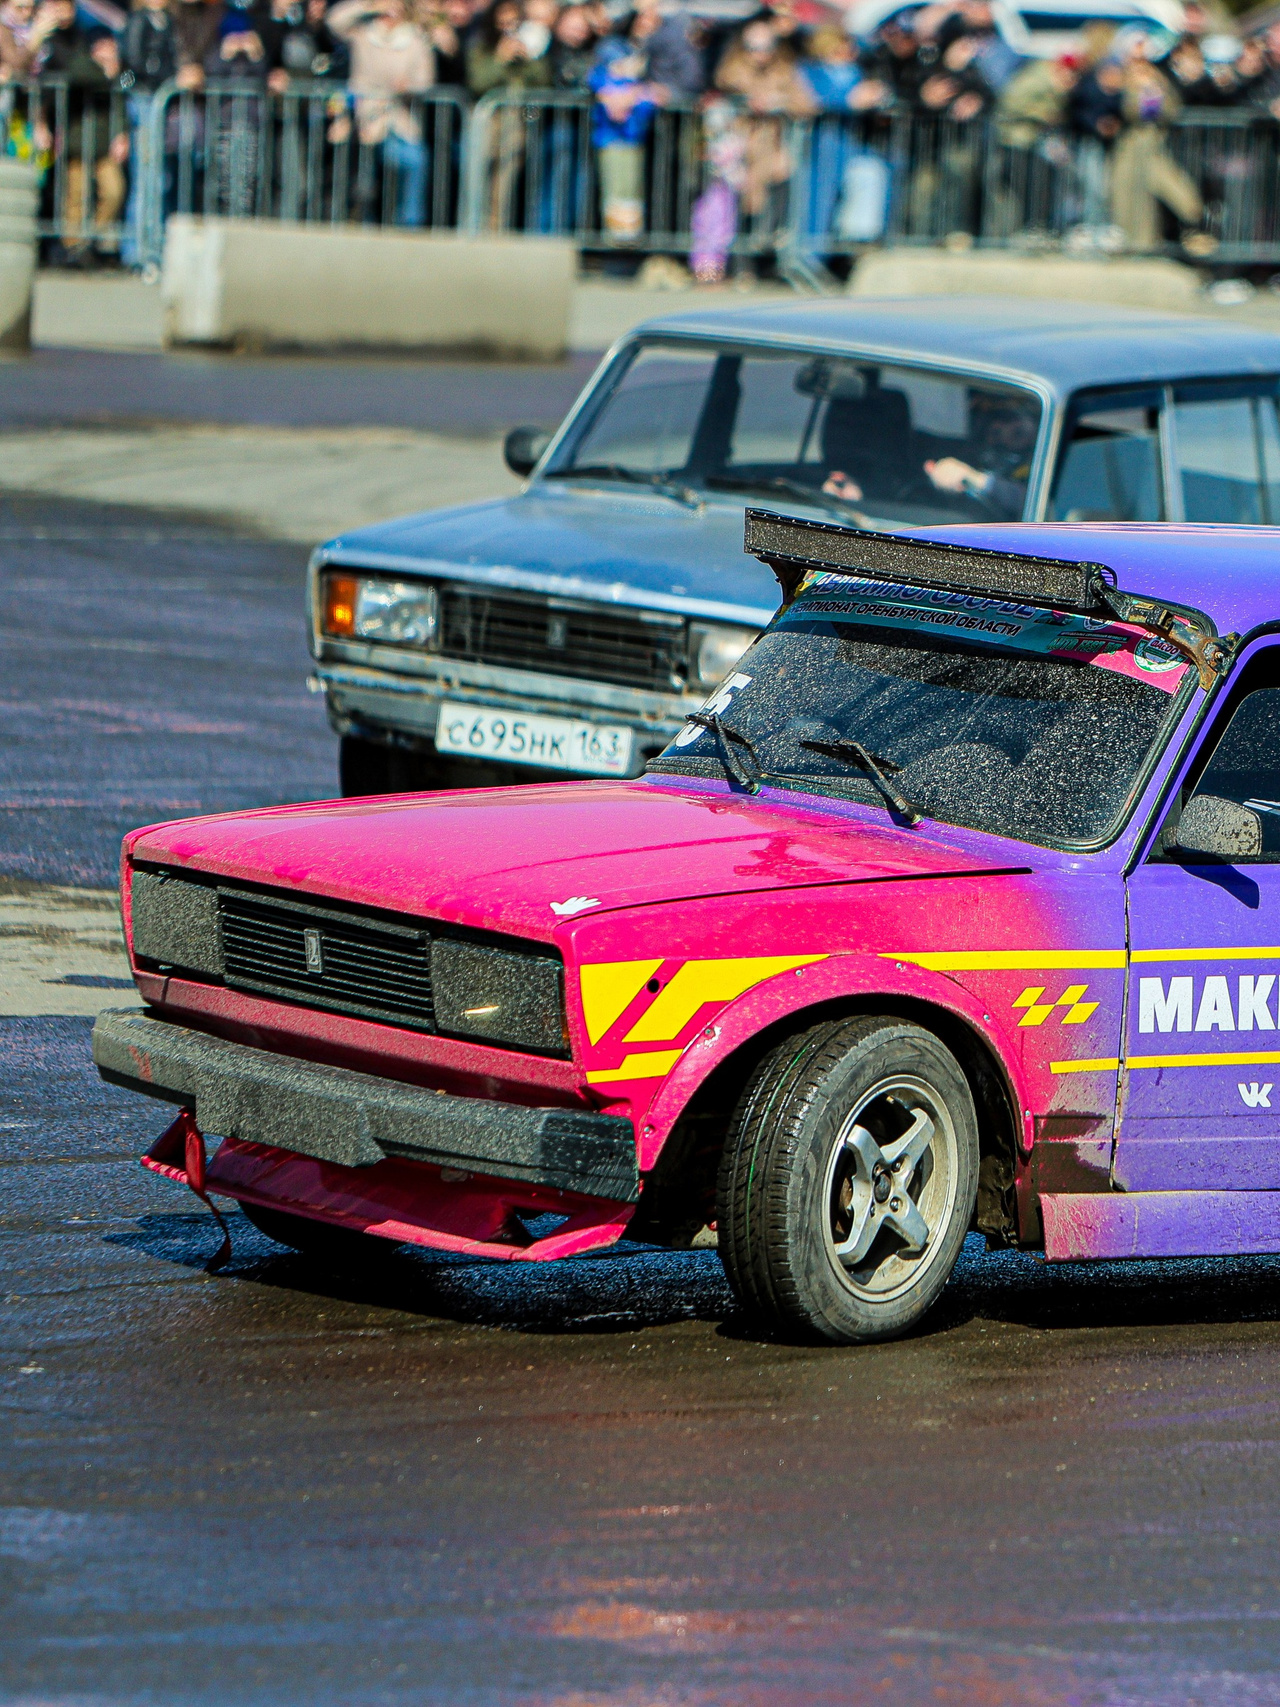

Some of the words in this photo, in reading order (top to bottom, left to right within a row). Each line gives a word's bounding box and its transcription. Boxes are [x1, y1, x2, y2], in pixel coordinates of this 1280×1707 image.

[856, 602, 957, 627] ОРЕНБУРГСКОЙ
[955, 613, 1024, 638] ОБЛАСТИ
[447, 716, 566, 760] С695НК
[576, 729, 621, 758] 163
